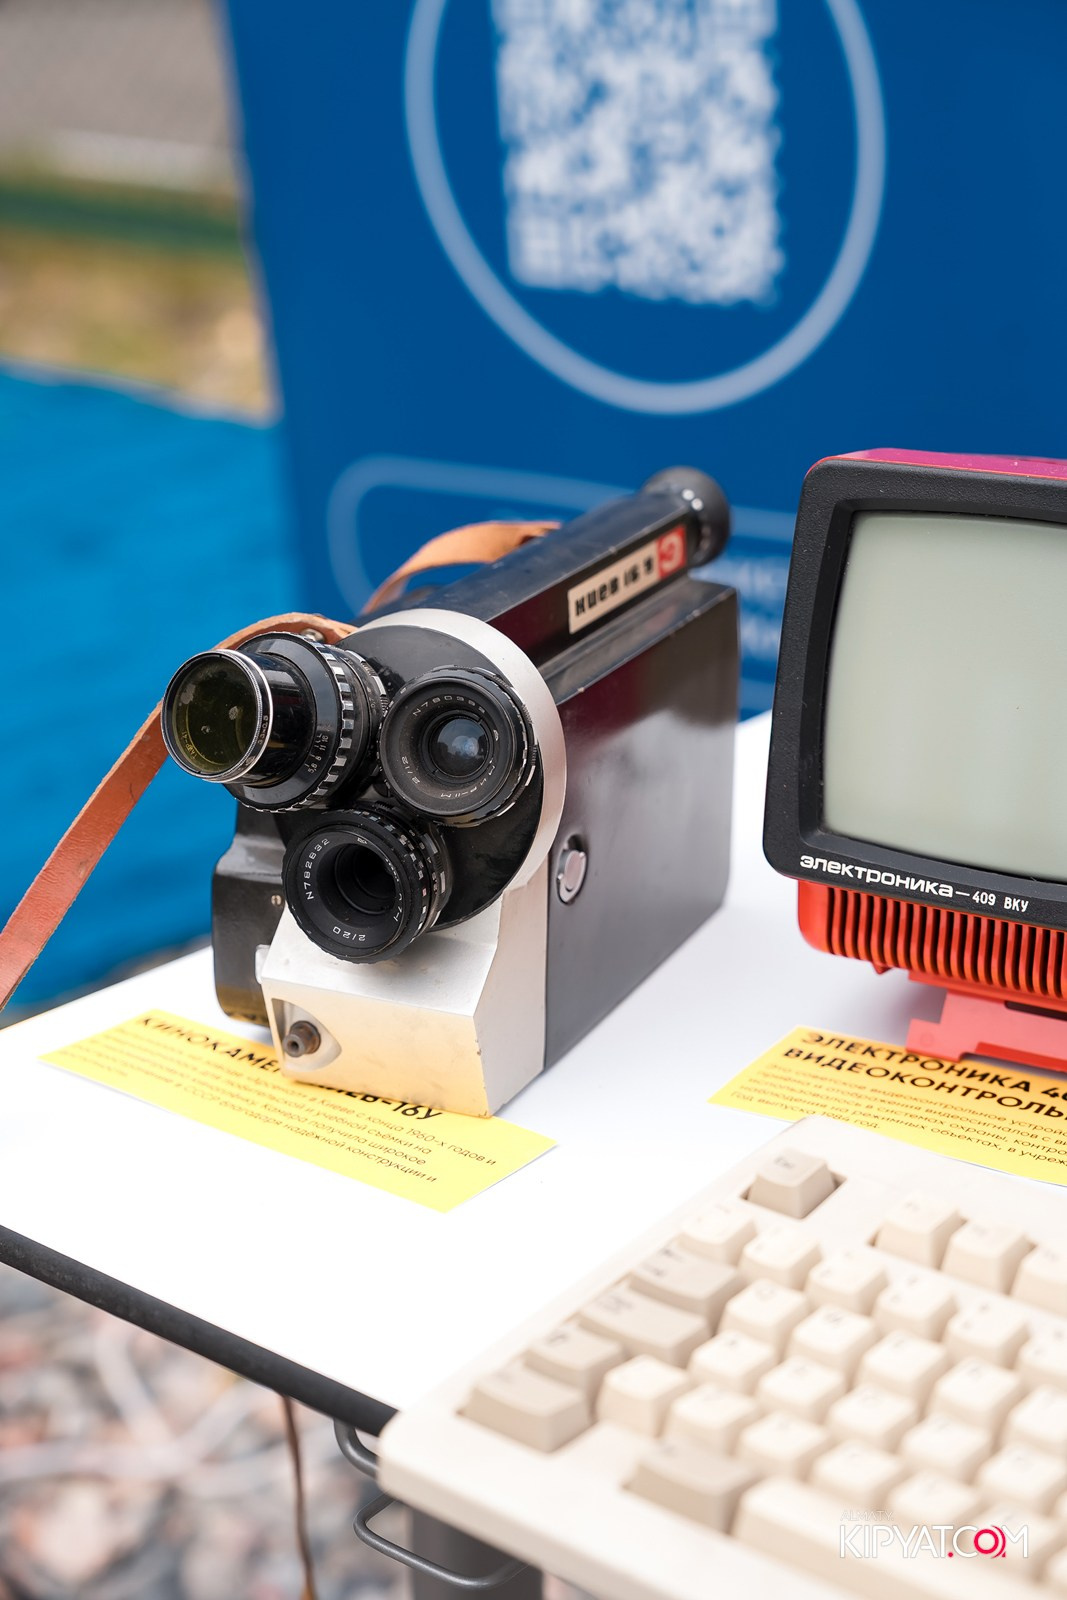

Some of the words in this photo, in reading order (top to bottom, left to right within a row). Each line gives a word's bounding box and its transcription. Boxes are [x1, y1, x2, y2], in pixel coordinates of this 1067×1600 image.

[332, 926, 367, 942] 2/20
[138, 1018, 281, 1073] КИНОКАМЕ
[801, 1032, 1031, 1093] ЭЛЕКТРОНИКА
[783, 1048, 1067, 1121] ВИДЕОКОНТРОЛЬ
[870, 1087, 1007, 1121] видеоконтрольное
[263, 1103, 308, 1123] Камера
[308, 1119, 367, 1144] получила
[368, 1141, 427, 1166] широкое
[315, 1111, 367, 1130] учебной
[413, 1145, 432, 1155] на
[320, 1099, 355, 1115] Киеве
[367, 1116, 405, 1133] конца
[406, 1128, 448, 1147] 1960-х
[447, 1144, 485, 1162] годов
[851, 1109, 926, 1130] режимных
[931, 1127, 1003, 1151] объектах,
[877, 1107, 944, 1125] системах
[949, 1122, 1008, 1143] охраны,
[925, 1107, 1039, 1140] видеосигналов
[346, 1145, 426, 1180] конструкции
